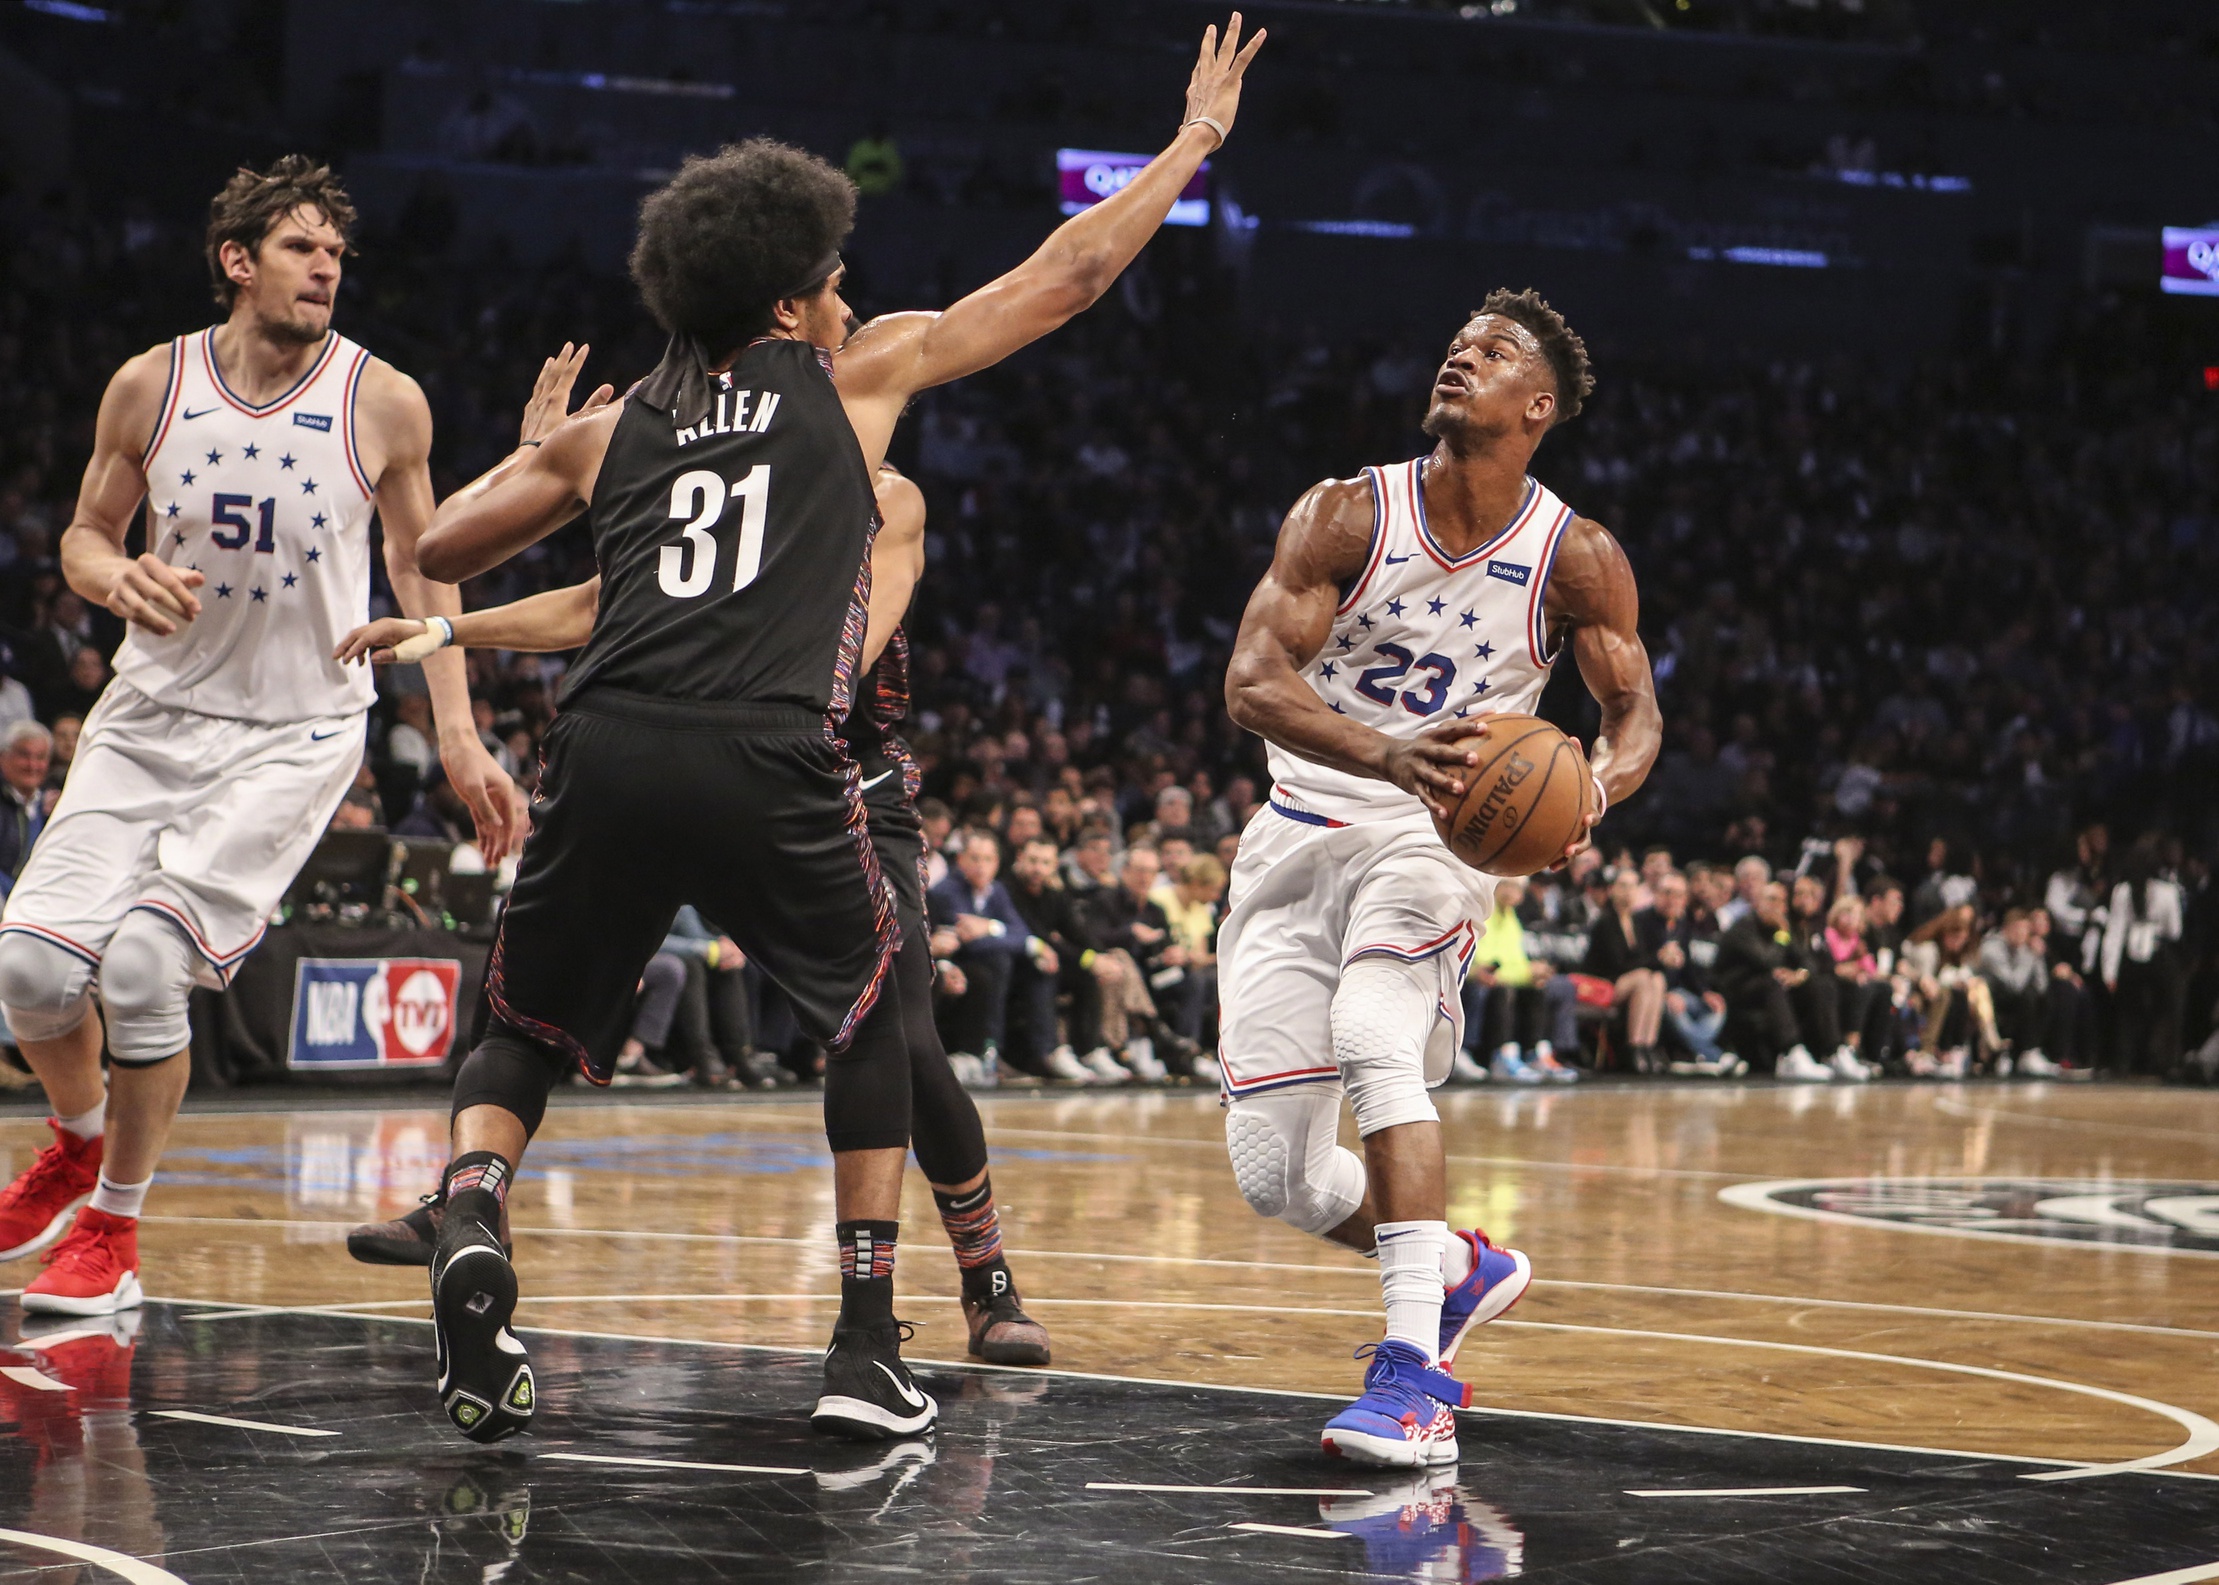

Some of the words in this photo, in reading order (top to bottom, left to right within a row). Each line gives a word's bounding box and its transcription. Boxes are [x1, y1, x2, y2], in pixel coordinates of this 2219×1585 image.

[211, 493, 276, 554] 51
[658, 465, 771, 598] 31
[1491, 564, 1525, 580] StubHub
[1355, 642, 1457, 717] 23
[1455, 751, 1535, 851] SPALDING
